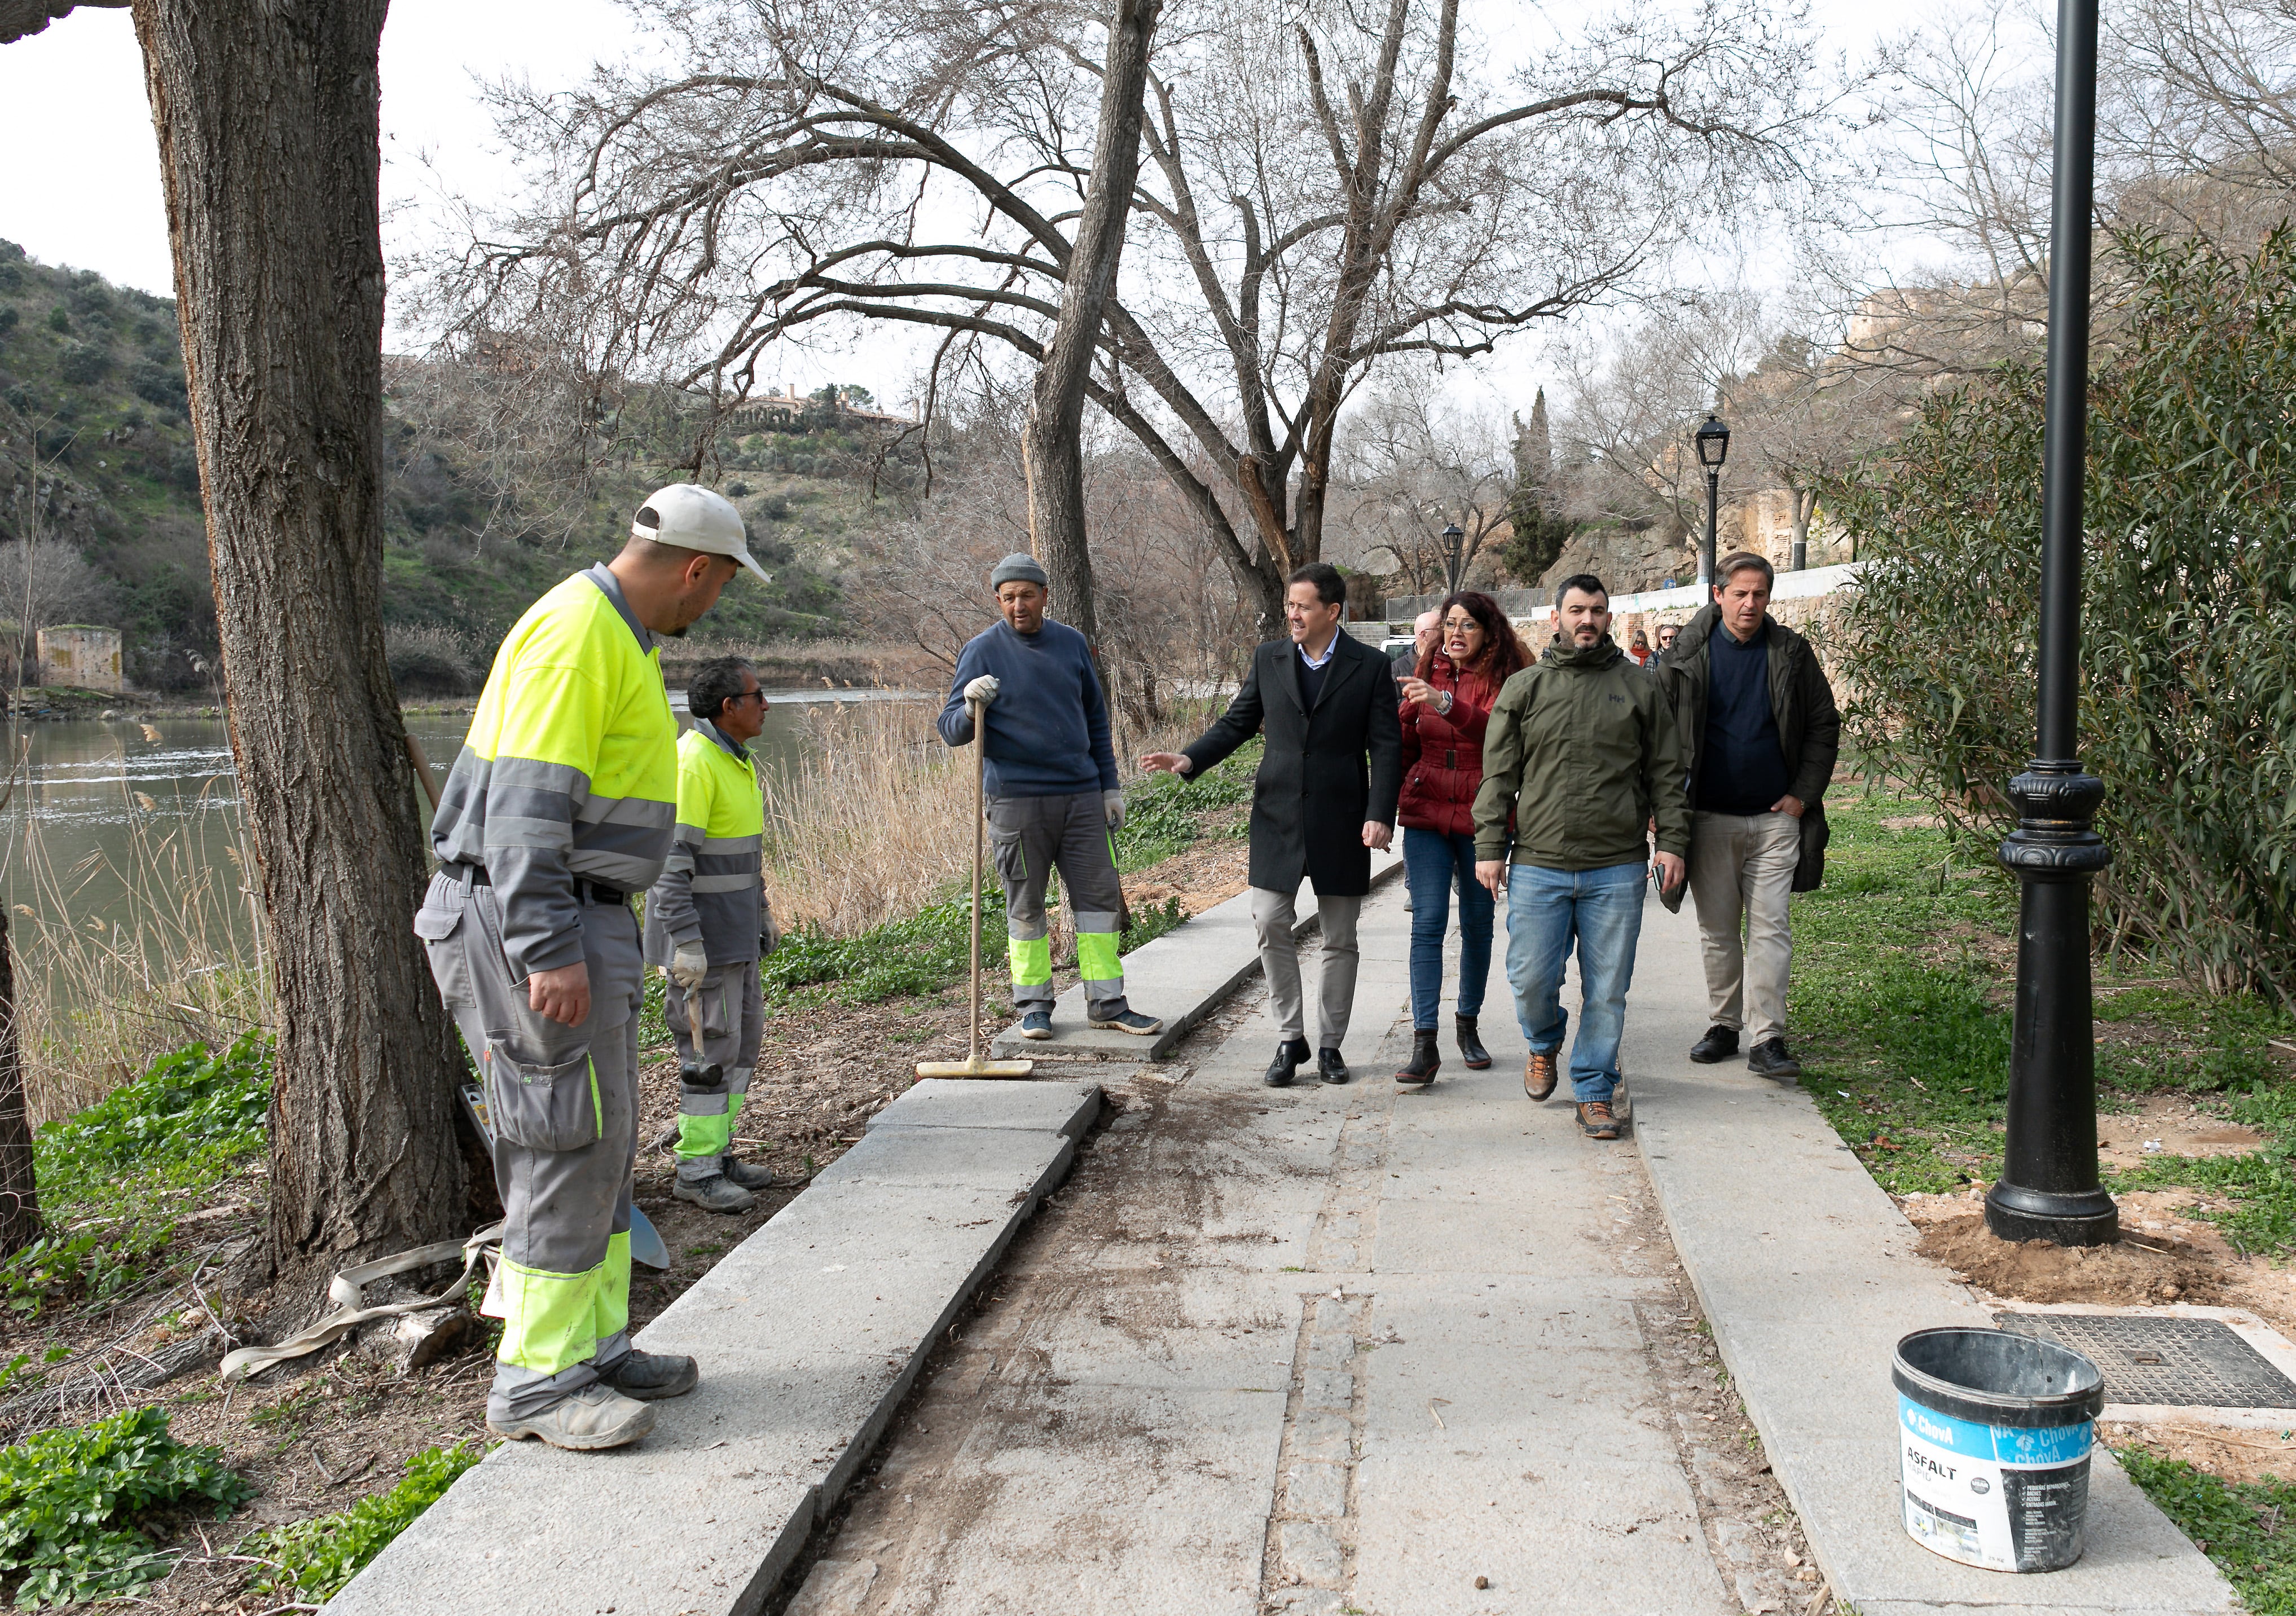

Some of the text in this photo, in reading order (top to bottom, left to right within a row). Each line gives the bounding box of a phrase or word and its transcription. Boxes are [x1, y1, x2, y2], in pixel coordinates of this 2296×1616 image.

[1609, 693, 1625, 703] HH
[1918, 1415, 1954, 1446] ChovA
[1908, 1447, 1956, 1481] ASFALT
